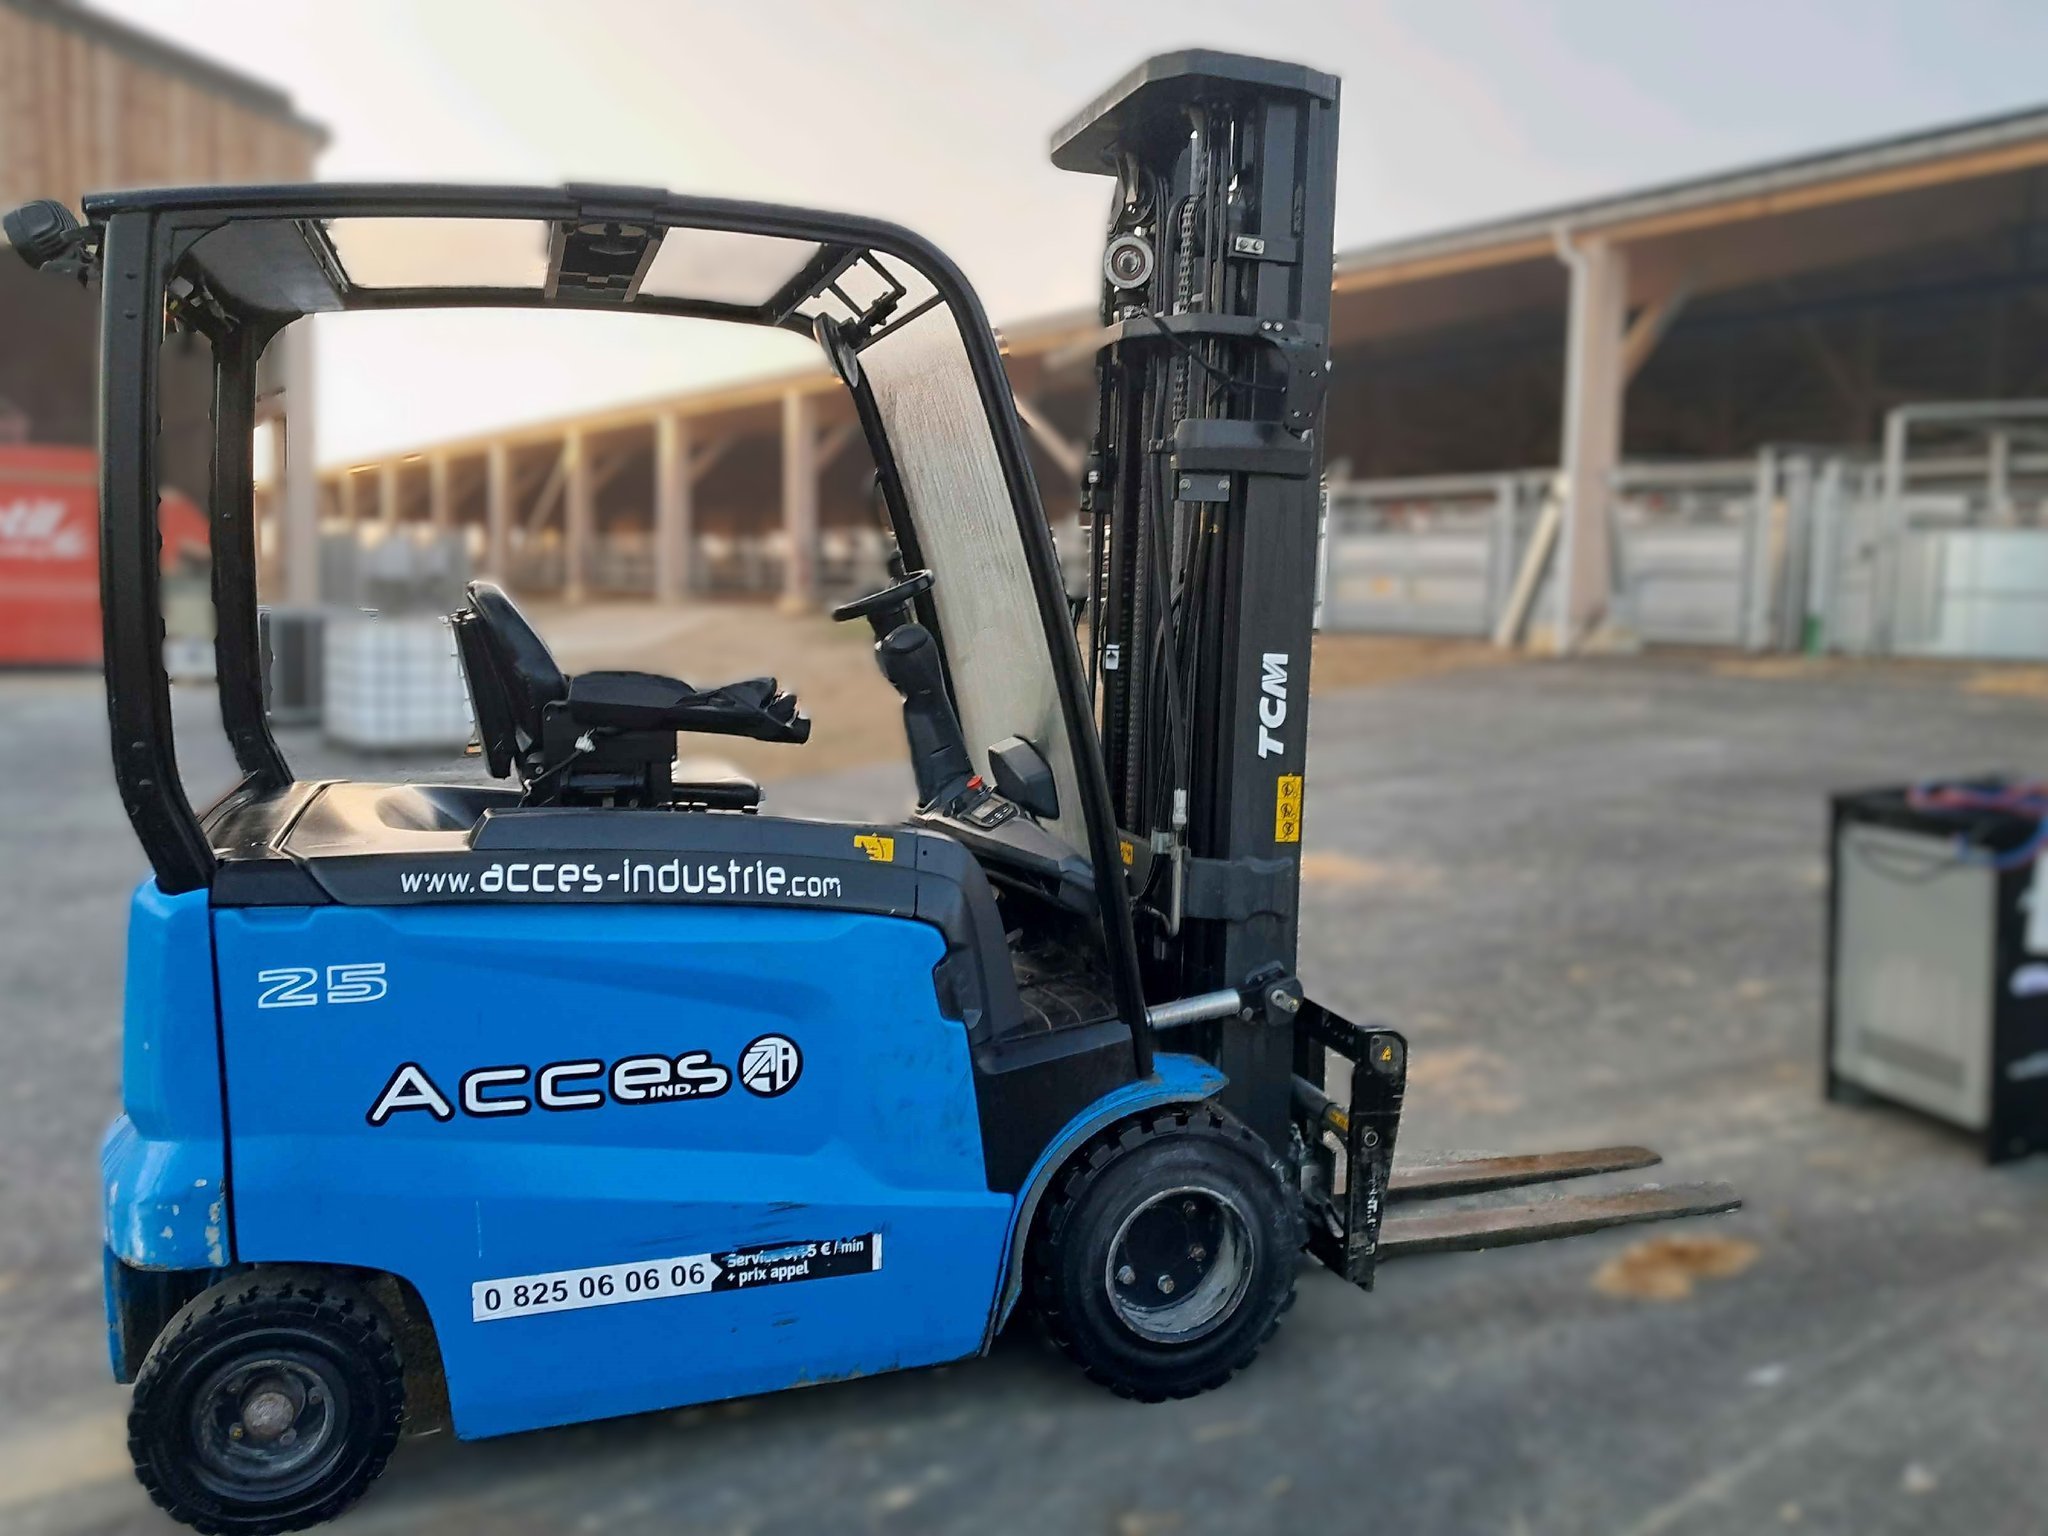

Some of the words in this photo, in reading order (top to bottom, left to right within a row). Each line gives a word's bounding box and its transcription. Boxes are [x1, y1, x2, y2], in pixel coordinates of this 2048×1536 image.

[1257, 652, 1289, 759] TCM
[400, 858, 842, 898] www.acces-industrie.com
[258, 962, 387, 1008] 25
[650, 1083, 697, 1098] IND.
[820, 1241, 831, 1255] €
[841, 1240, 864, 1254] min
[484, 1288, 501, 1310] 0
[513, 1280, 568, 1307] 825
[579, 1274, 614, 1298] 06
[625, 1268, 660, 1292] 06
[671, 1263, 705, 1287] 06
[738, 1266, 767, 1287] prix
[770, 1260, 809, 1281] appel
